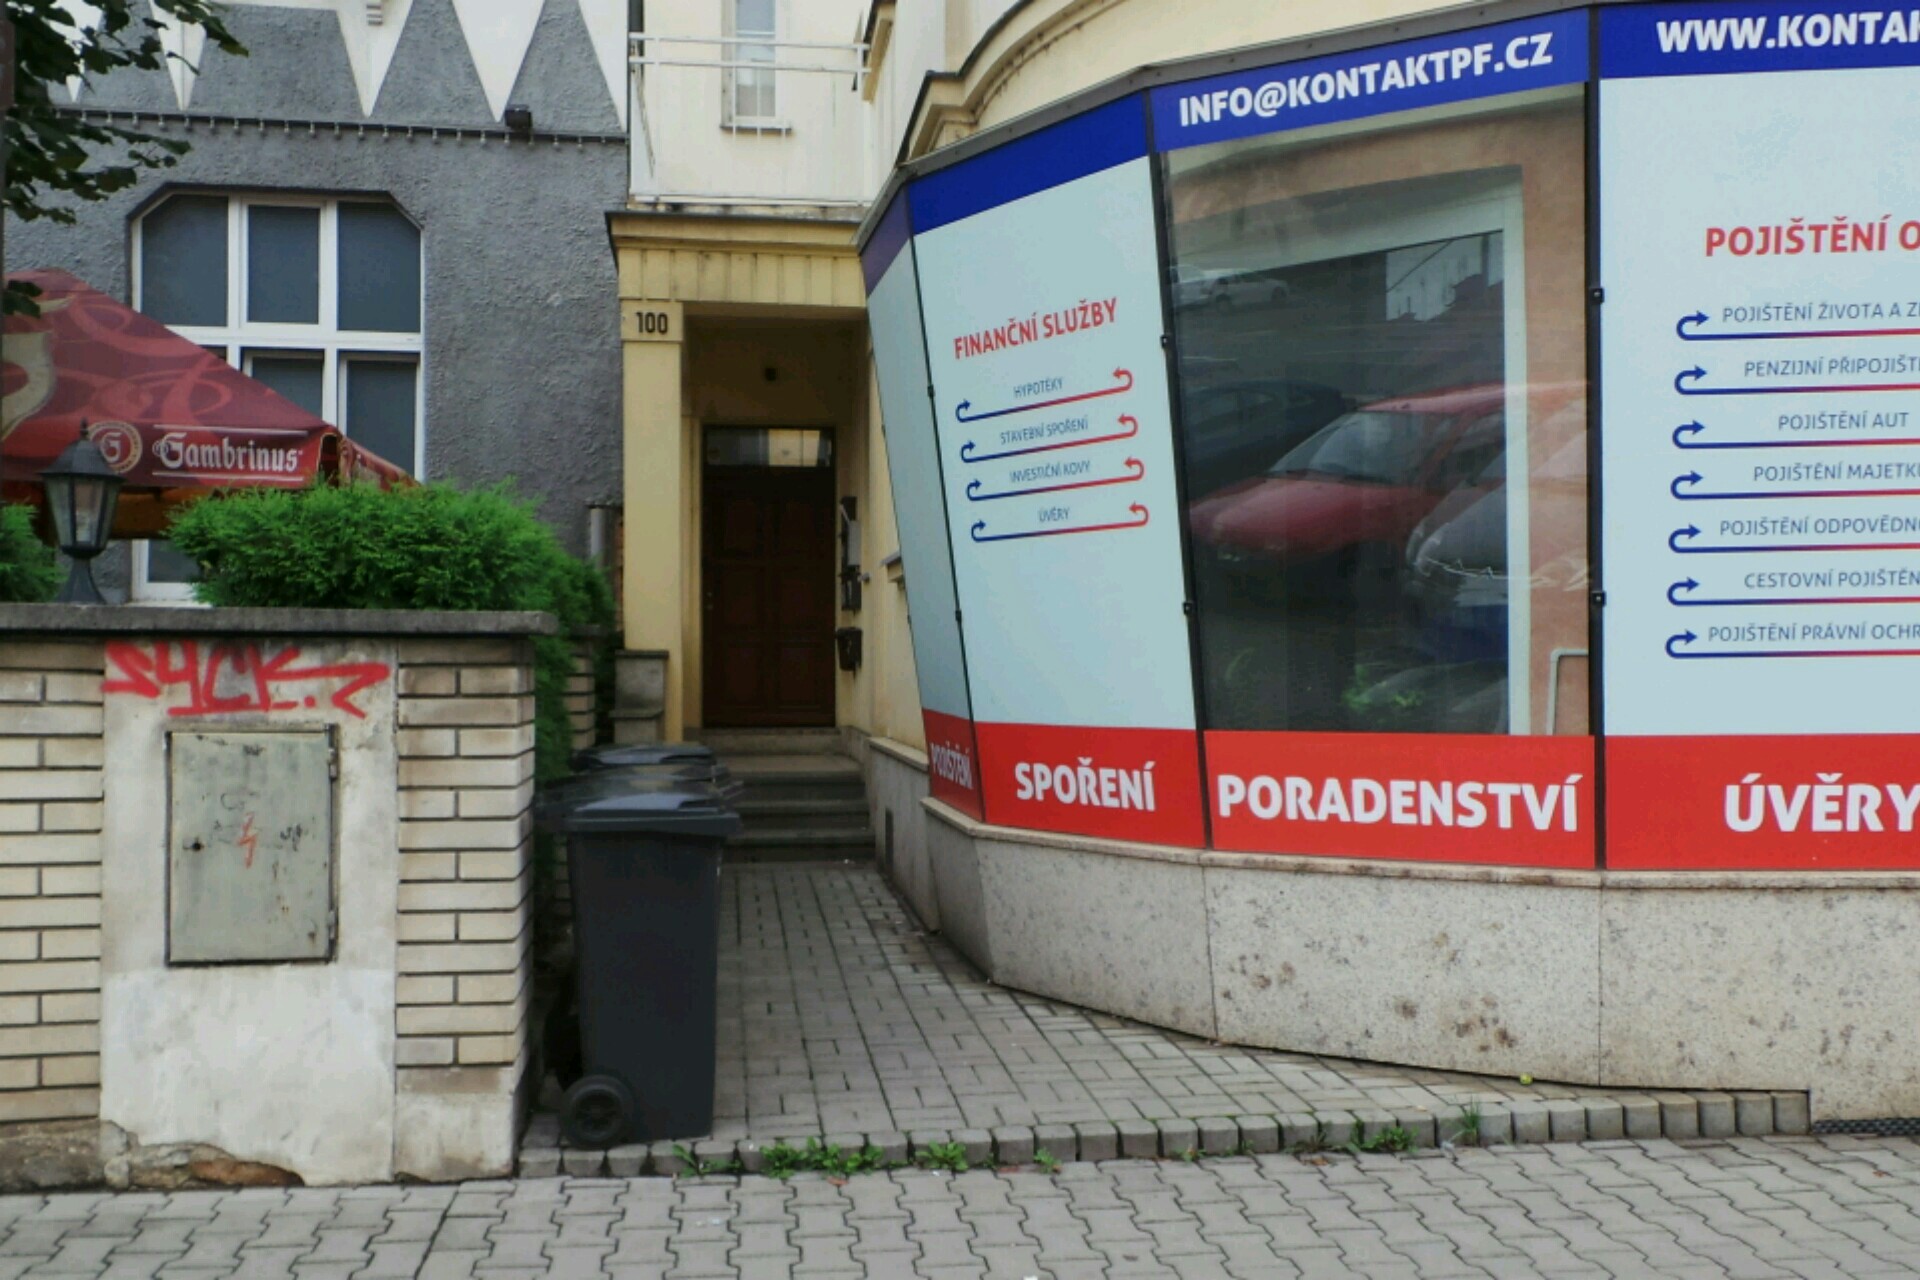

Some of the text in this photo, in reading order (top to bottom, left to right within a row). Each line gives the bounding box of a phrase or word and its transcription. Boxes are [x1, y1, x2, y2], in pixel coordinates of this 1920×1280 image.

[1179, 31, 1553, 127] INFO@KONTAKTPF.CZ
[1705, 214, 1892, 257] POJIŠTĚNÍ
[635, 312, 669, 335] 100
[1722, 302, 1920, 323] POJIŠTĚNÍ ŽIVOTA A Z
[954, 297, 1118, 359] FINANČNÍ SLUŽBY
[1744, 357, 1823, 377] PENZIJNÍ
[1013, 377, 1063, 398] HYPOTÉKY
[1000, 414, 1089, 445] STAVEBNÍ SPOŘENÍ
[1778, 410, 1909, 431] POJIŠTĚNÍ AUT
[152, 432, 299, 472] Gambrinus
[1009, 460, 1090, 483] INVESTIČNÍ KOVY
[1753, 461, 1843, 482] POJIŠTĚNÍ
[1038, 507, 1070, 522] ÚVĚRY
[1720, 514, 1920, 536] POJIŠTĚNÍ ODPOVĚDN
[1744, 568, 1834, 589] CESTOVNÍ
[1708, 622, 1798, 642] POJIŠTĚNÍ
[1802, 622, 1867, 641] PRÁVNÍ
[1015, 757, 1156, 812] SPOŘENÍ
[1218, 774, 1583, 832] PORADENSTVÍ
[1725, 772, 1920, 832] ÚVĚRY
